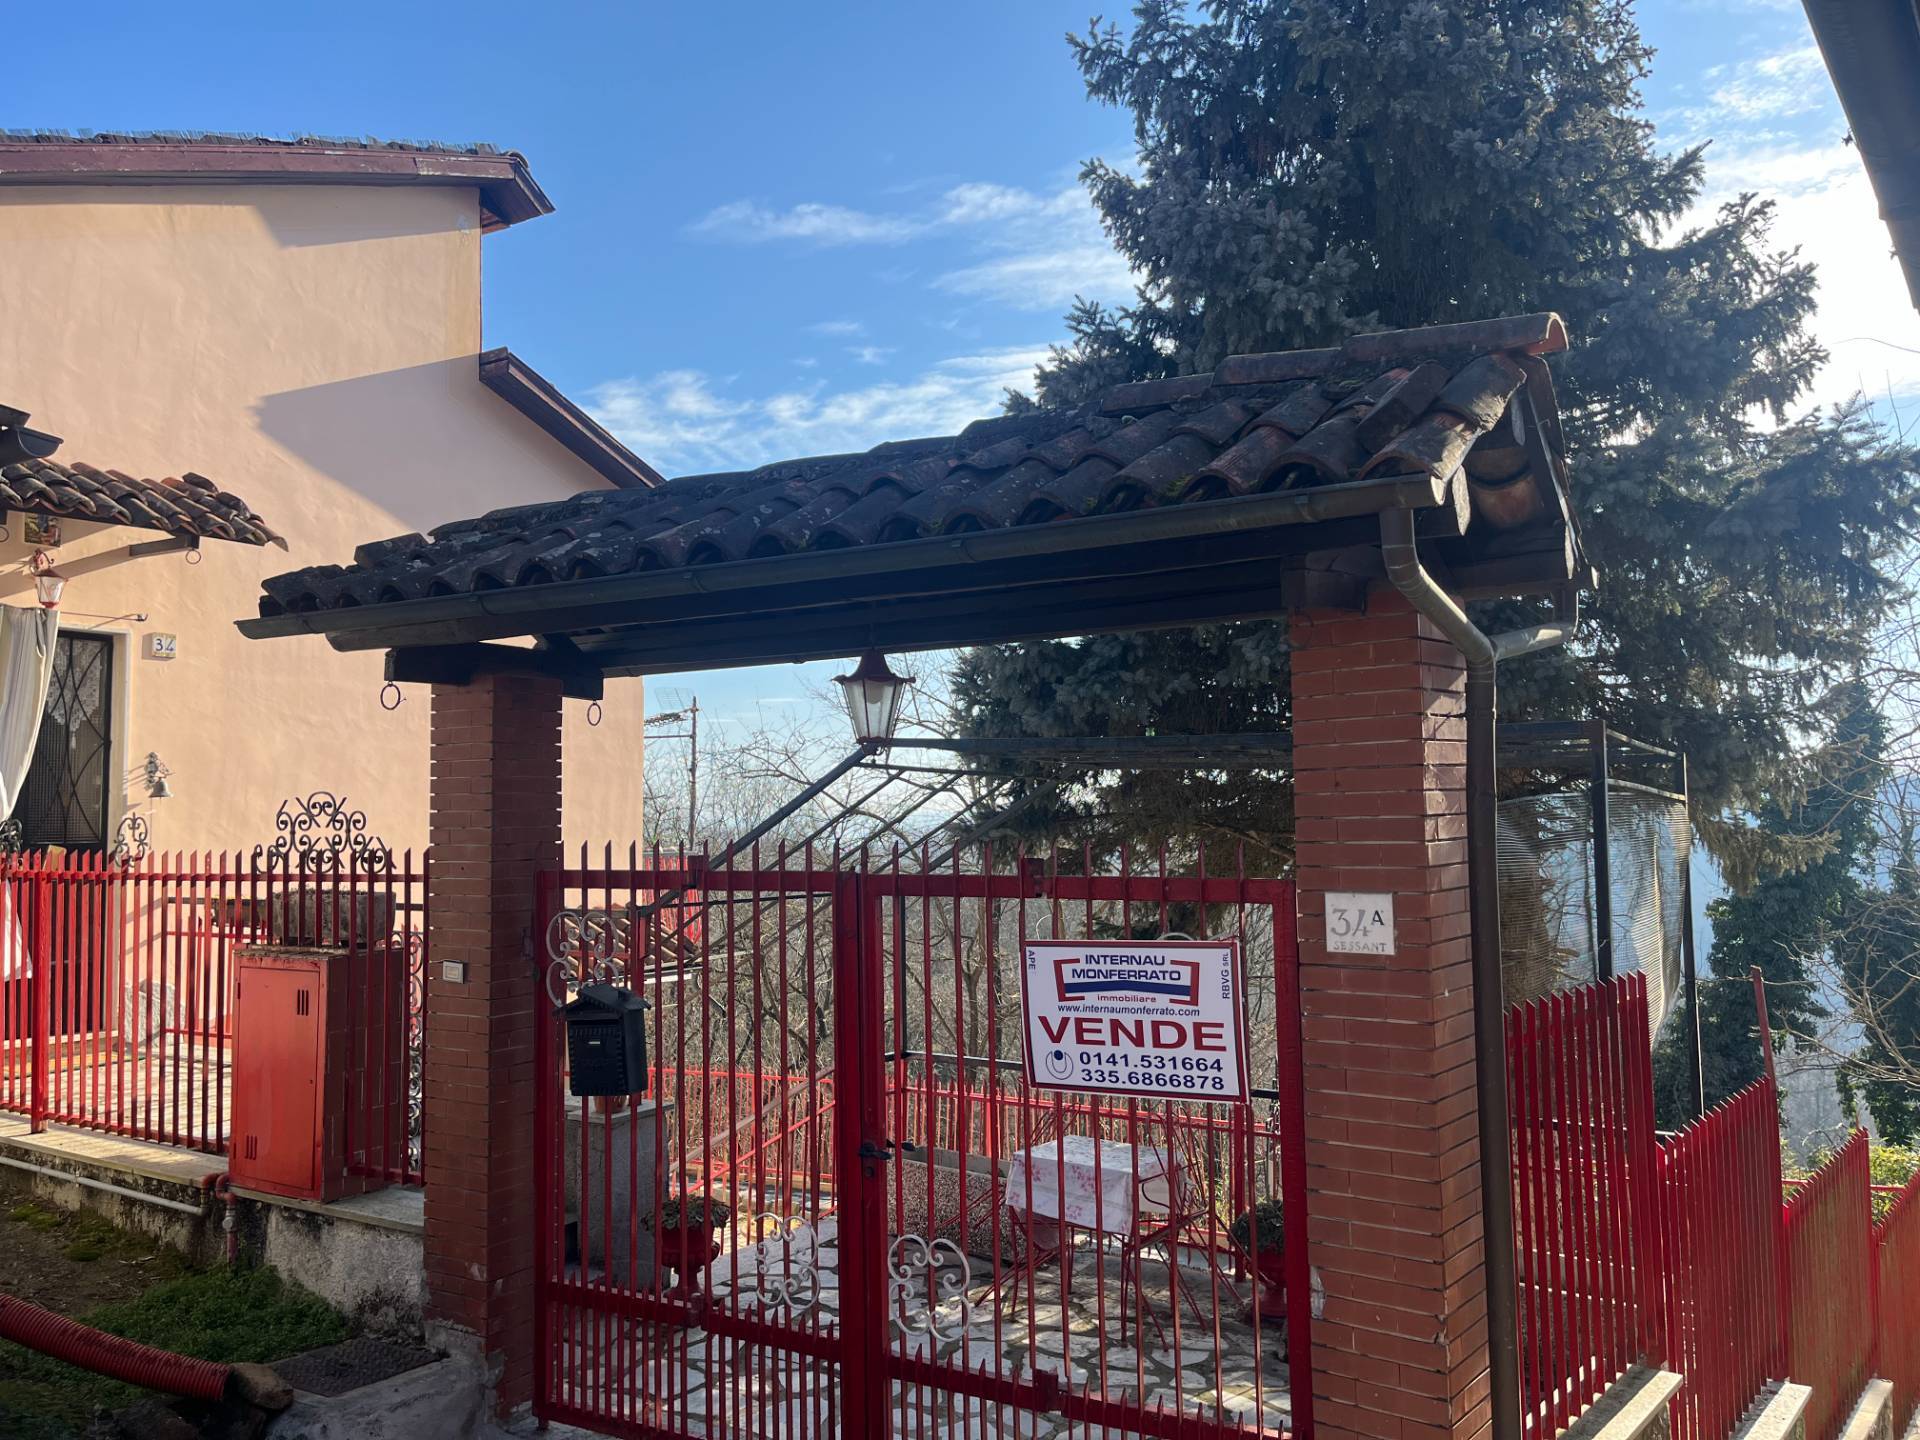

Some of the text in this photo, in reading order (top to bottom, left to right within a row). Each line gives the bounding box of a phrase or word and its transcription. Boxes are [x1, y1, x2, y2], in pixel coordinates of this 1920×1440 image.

[156, 638, 174, 652] 34
[1028, 950, 1036, 970] APE
[1085, 954, 1166, 967] INTERNAU
[1072, 968, 1181, 981] MONFERRATO
[1221, 969, 1231, 1000] RBVG
[1097, 994, 1157, 1003] immobiliare
[1058, 1003, 1200, 1017] www.internaumonferrato.com
[1038, 1015, 1227, 1052] VENDE
[1079, 1051, 1223, 1073] 0141.531664
[1081, 1069, 1224, 1091] 335.6866878
